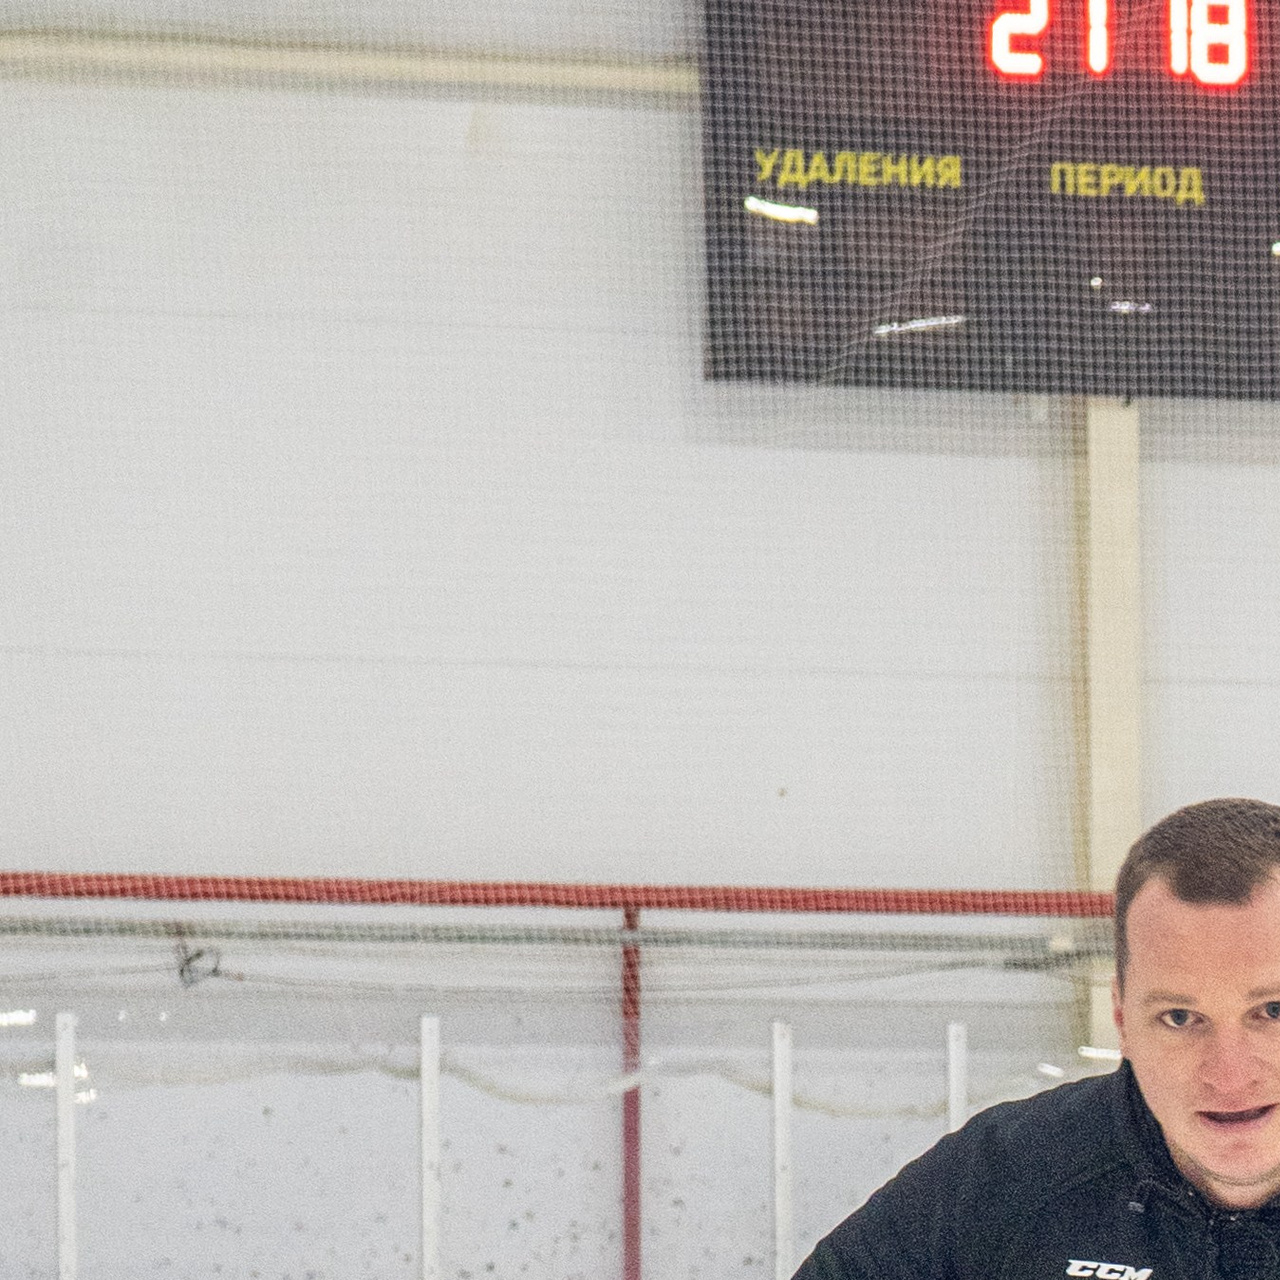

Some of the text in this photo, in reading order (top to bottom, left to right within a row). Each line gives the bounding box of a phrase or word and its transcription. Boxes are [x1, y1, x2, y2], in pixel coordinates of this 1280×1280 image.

[1169, 0, 1247, 84] 18
[754, 149, 962, 188] УДАЛЕНИЯ
[1050, 163, 1206, 204] ПЕРИОД
